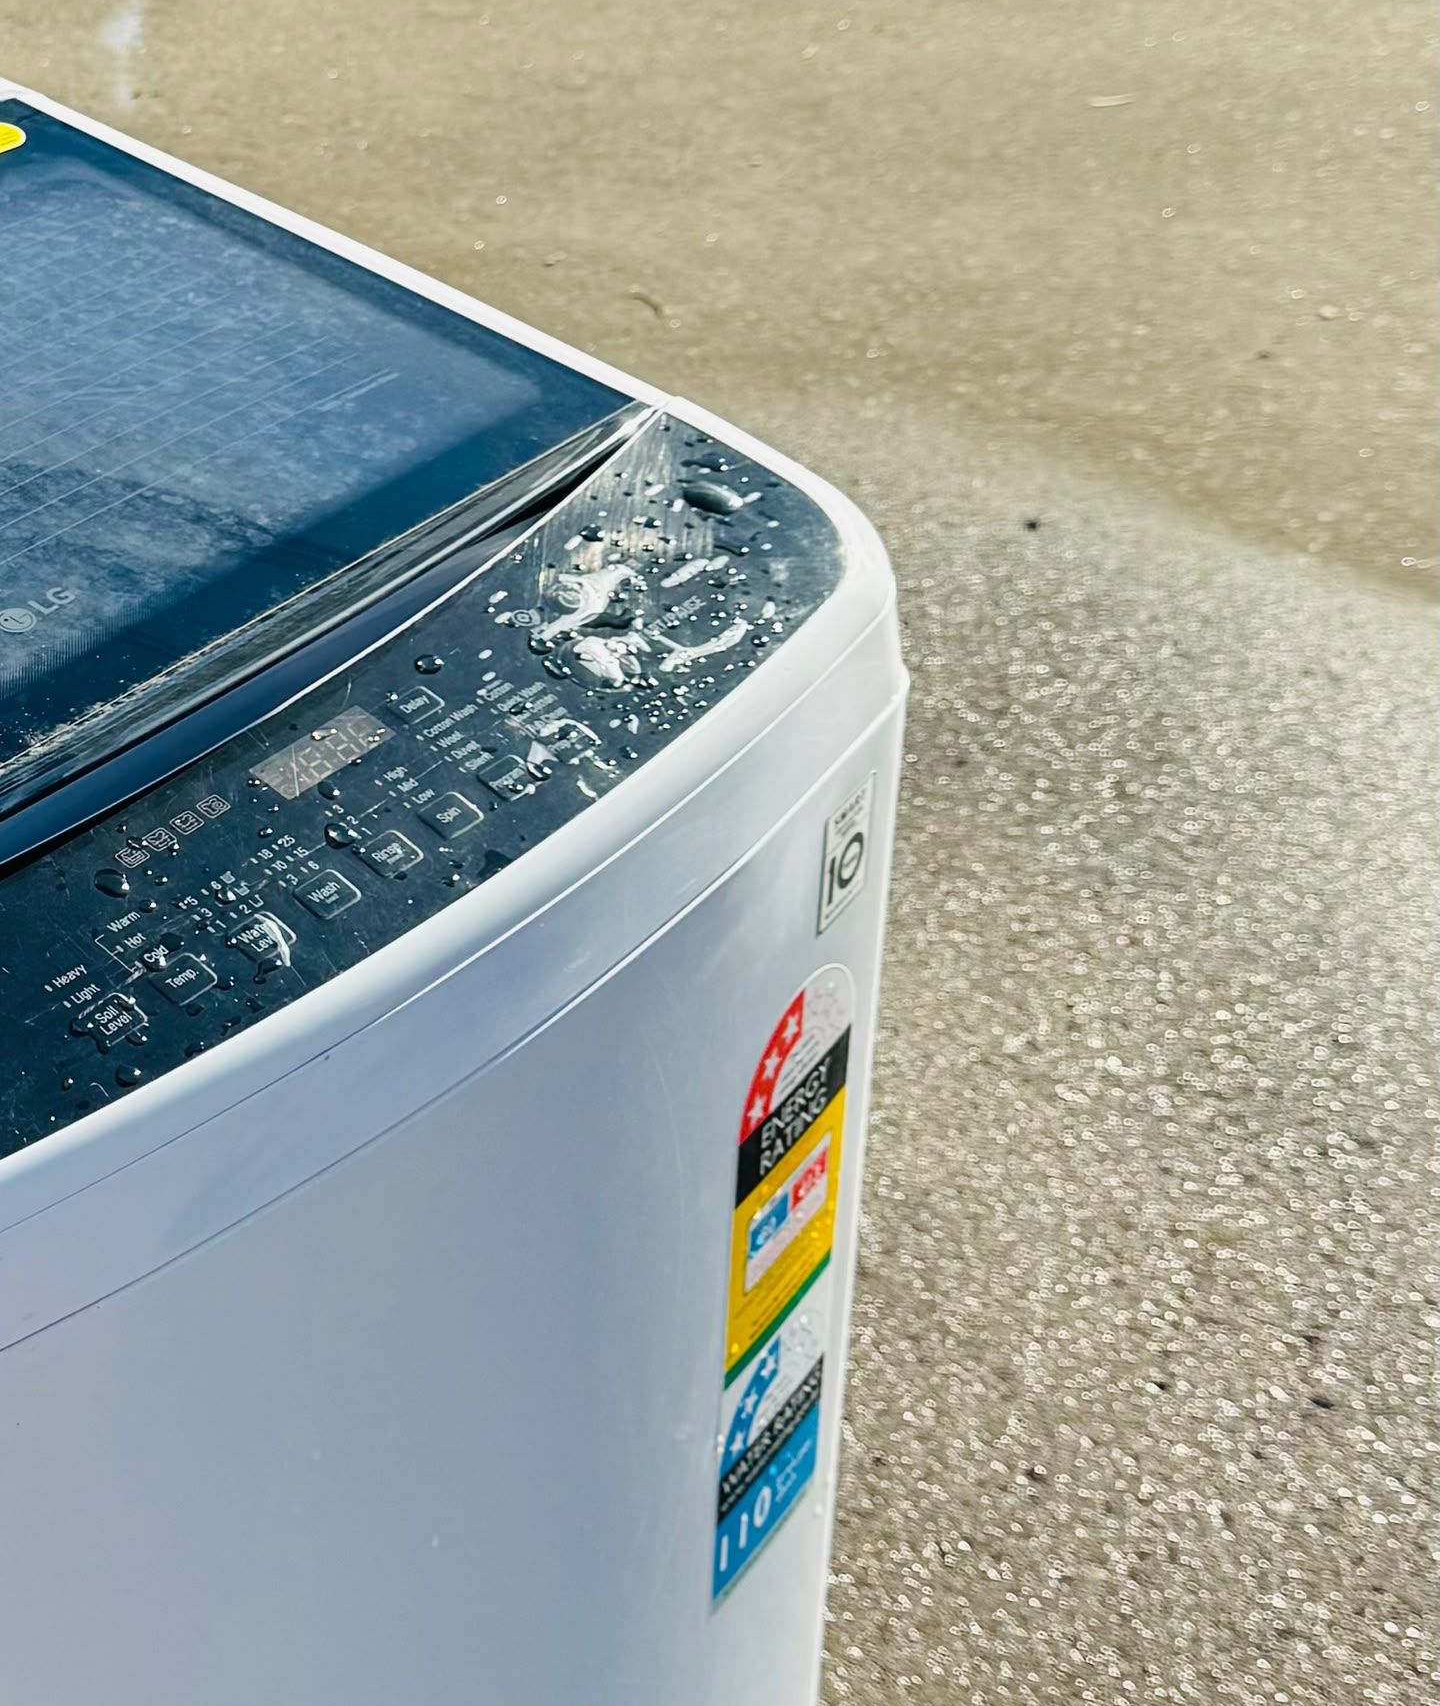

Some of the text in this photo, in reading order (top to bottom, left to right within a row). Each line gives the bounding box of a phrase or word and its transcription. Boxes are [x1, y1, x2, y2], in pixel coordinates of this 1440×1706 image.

[27, 586, 76, 614] LG
[399, 695, 430, 714] Delay
[423, 703, 479, 738] Cotton Wash
[383, 766, 408, 782] High
[397, 778, 419, 793] Mid
[412, 789, 435, 804] Low
[333, 804, 344, 814] 3
[436, 807, 462, 824] Spin
[347, 815, 359, 825] 2
[279, 834, 295, 847] 25
[257, 848, 273, 860] 18
[293, 847, 309, 858] 15
[371, 842, 403, 863] Rinse
[272, 860, 288, 872] 10
[309, 861, 320, 870] 6
[211, 881, 222, 891] 6
[286, 874, 299, 885] 3
[308, 881, 341, 903] Wash
[201, 907, 213, 918] 3
[239, 904, 251, 914] 2
[107, 910, 141, 933] Warm
[124, 932, 147, 949] Hot
[143, 944, 169, 964] Cold
[52, 964, 88, 988] Heavy
[165, 967, 199, 989] Temp.
[71, 983, 101, 1004] Light
[94, 1005, 120, 1024] Soil
[100, 1012, 133, 1036] Level
[762, 1057, 831, 1148] ENERGY
[760, 1087, 827, 1175] RATING
[719, 1486, 772, 1573] 110
